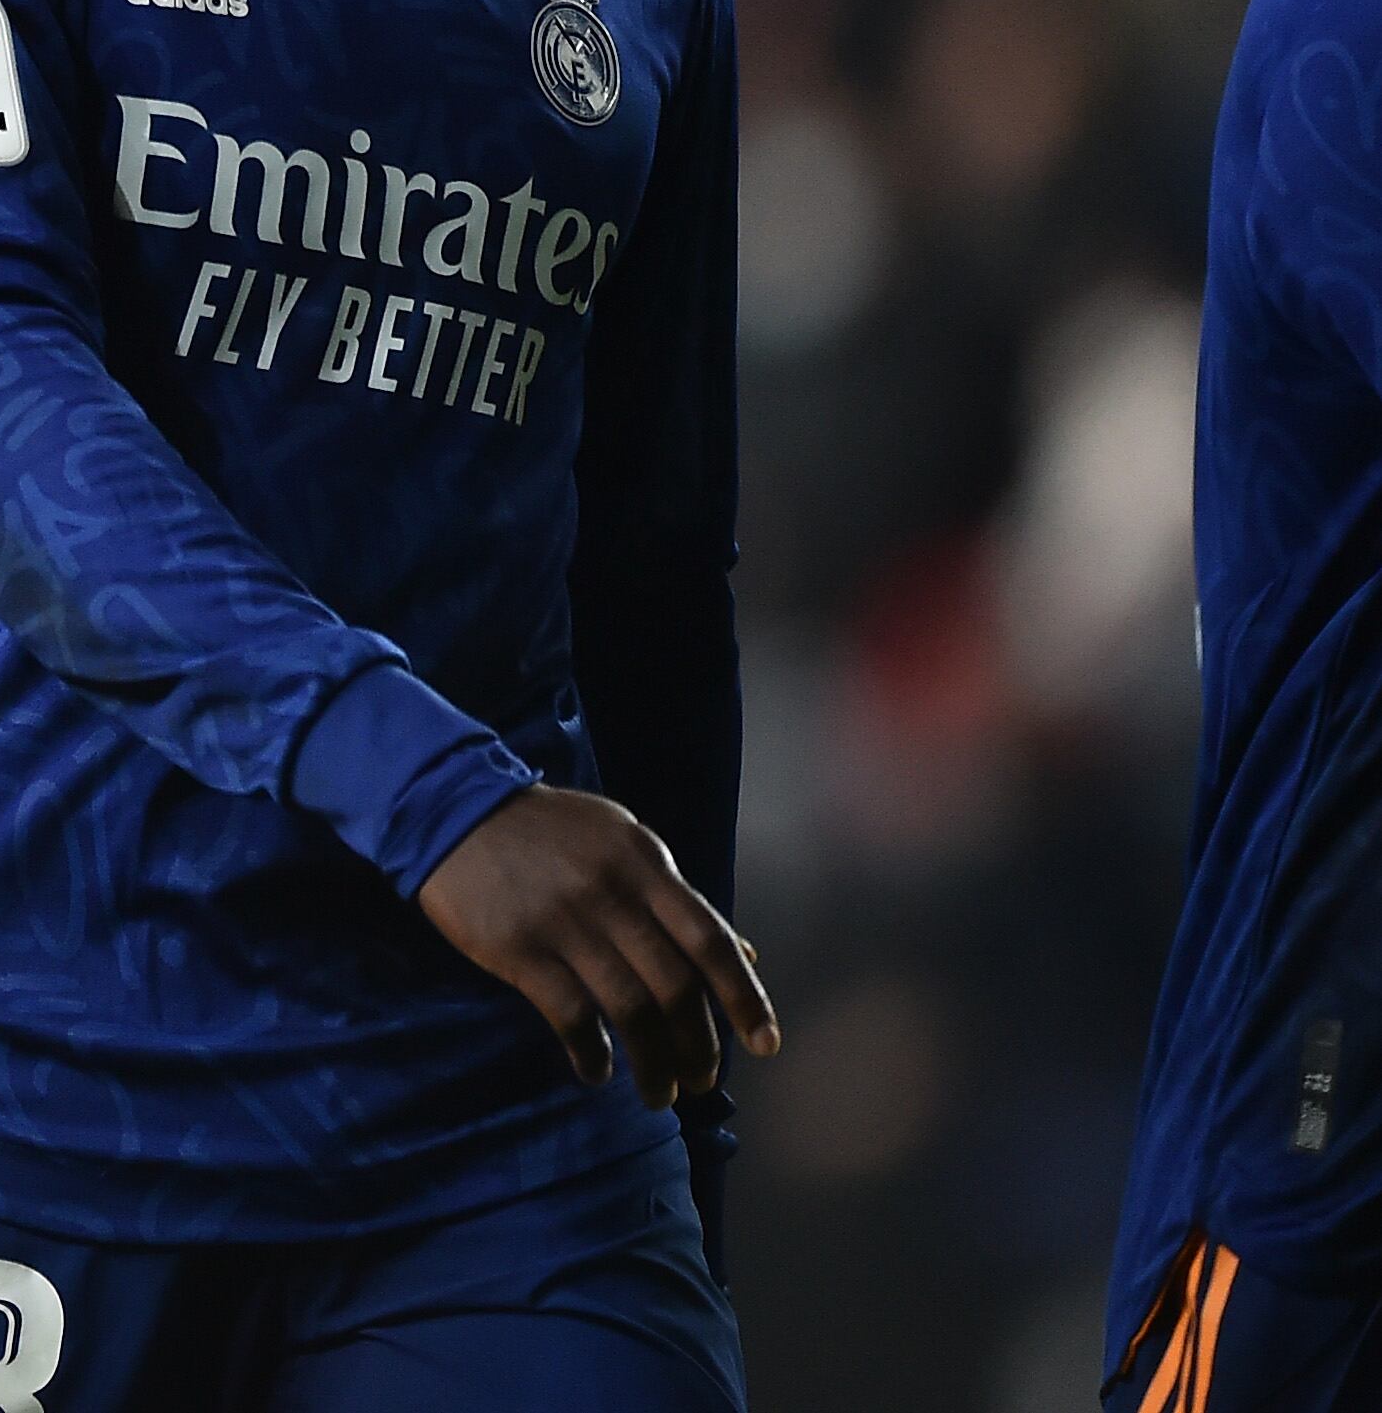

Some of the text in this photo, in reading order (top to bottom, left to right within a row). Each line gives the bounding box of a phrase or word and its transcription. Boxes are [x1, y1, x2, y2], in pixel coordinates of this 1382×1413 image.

[113, 94, 619, 316] Emirates
[174, 261, 546, 427] FLY BETTER
